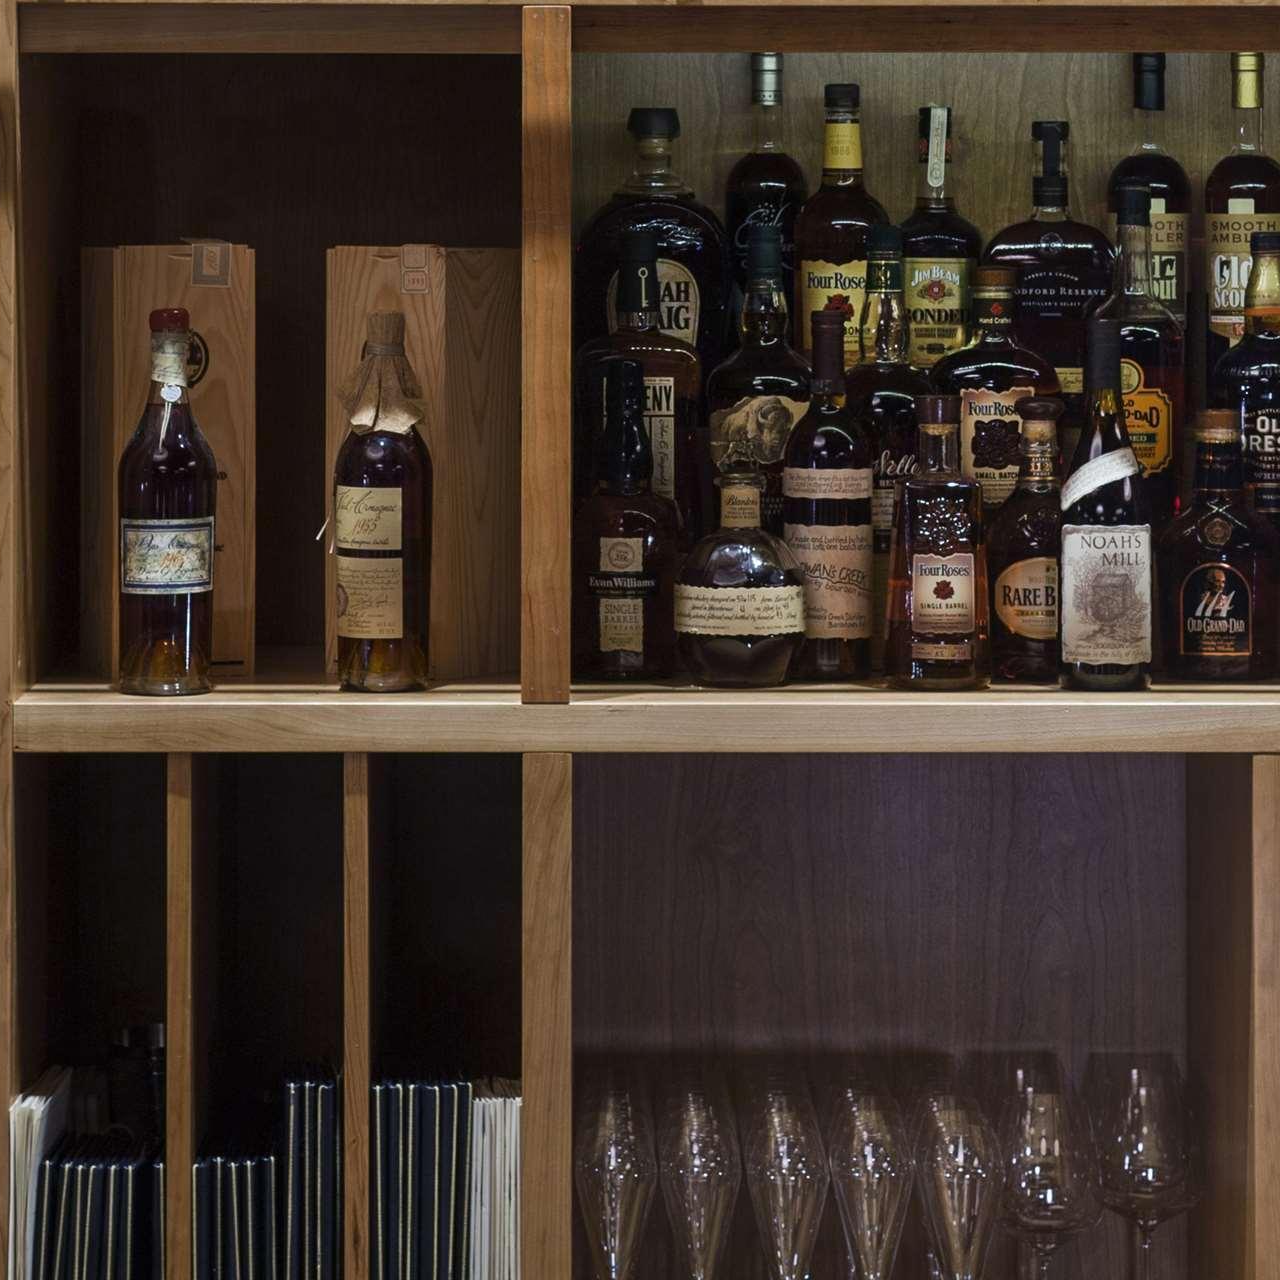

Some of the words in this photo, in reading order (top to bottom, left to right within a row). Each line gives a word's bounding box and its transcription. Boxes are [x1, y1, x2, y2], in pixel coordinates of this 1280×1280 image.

[1154, 221, 1184, 231] OTH
[1212, 220, 1276, 231] SMOOTH
[1155, 233, 1183, 243] LER
[1212, 232, 1251, 243] AMBL
[807, 271, 830, 289] Four
[832, 271, 865, 289] Rose
[911, 269, 930, 287] JIM
[931, 265, 960, 286] BEAM
[967, 401, 991, 416] Four
[1102, 552, 1145, 567] MILL
[919, 564, 940, 577] Four
[941, 564, 970, 577] Roses
[590, 575, 613, 589] Evan
[613, 574, 656, 589] Williams
[1002, 585, 1032, 607] RARE
[920, 602, 942, 610] SINGLE
[1187, 617, 1202, 633] OLD
